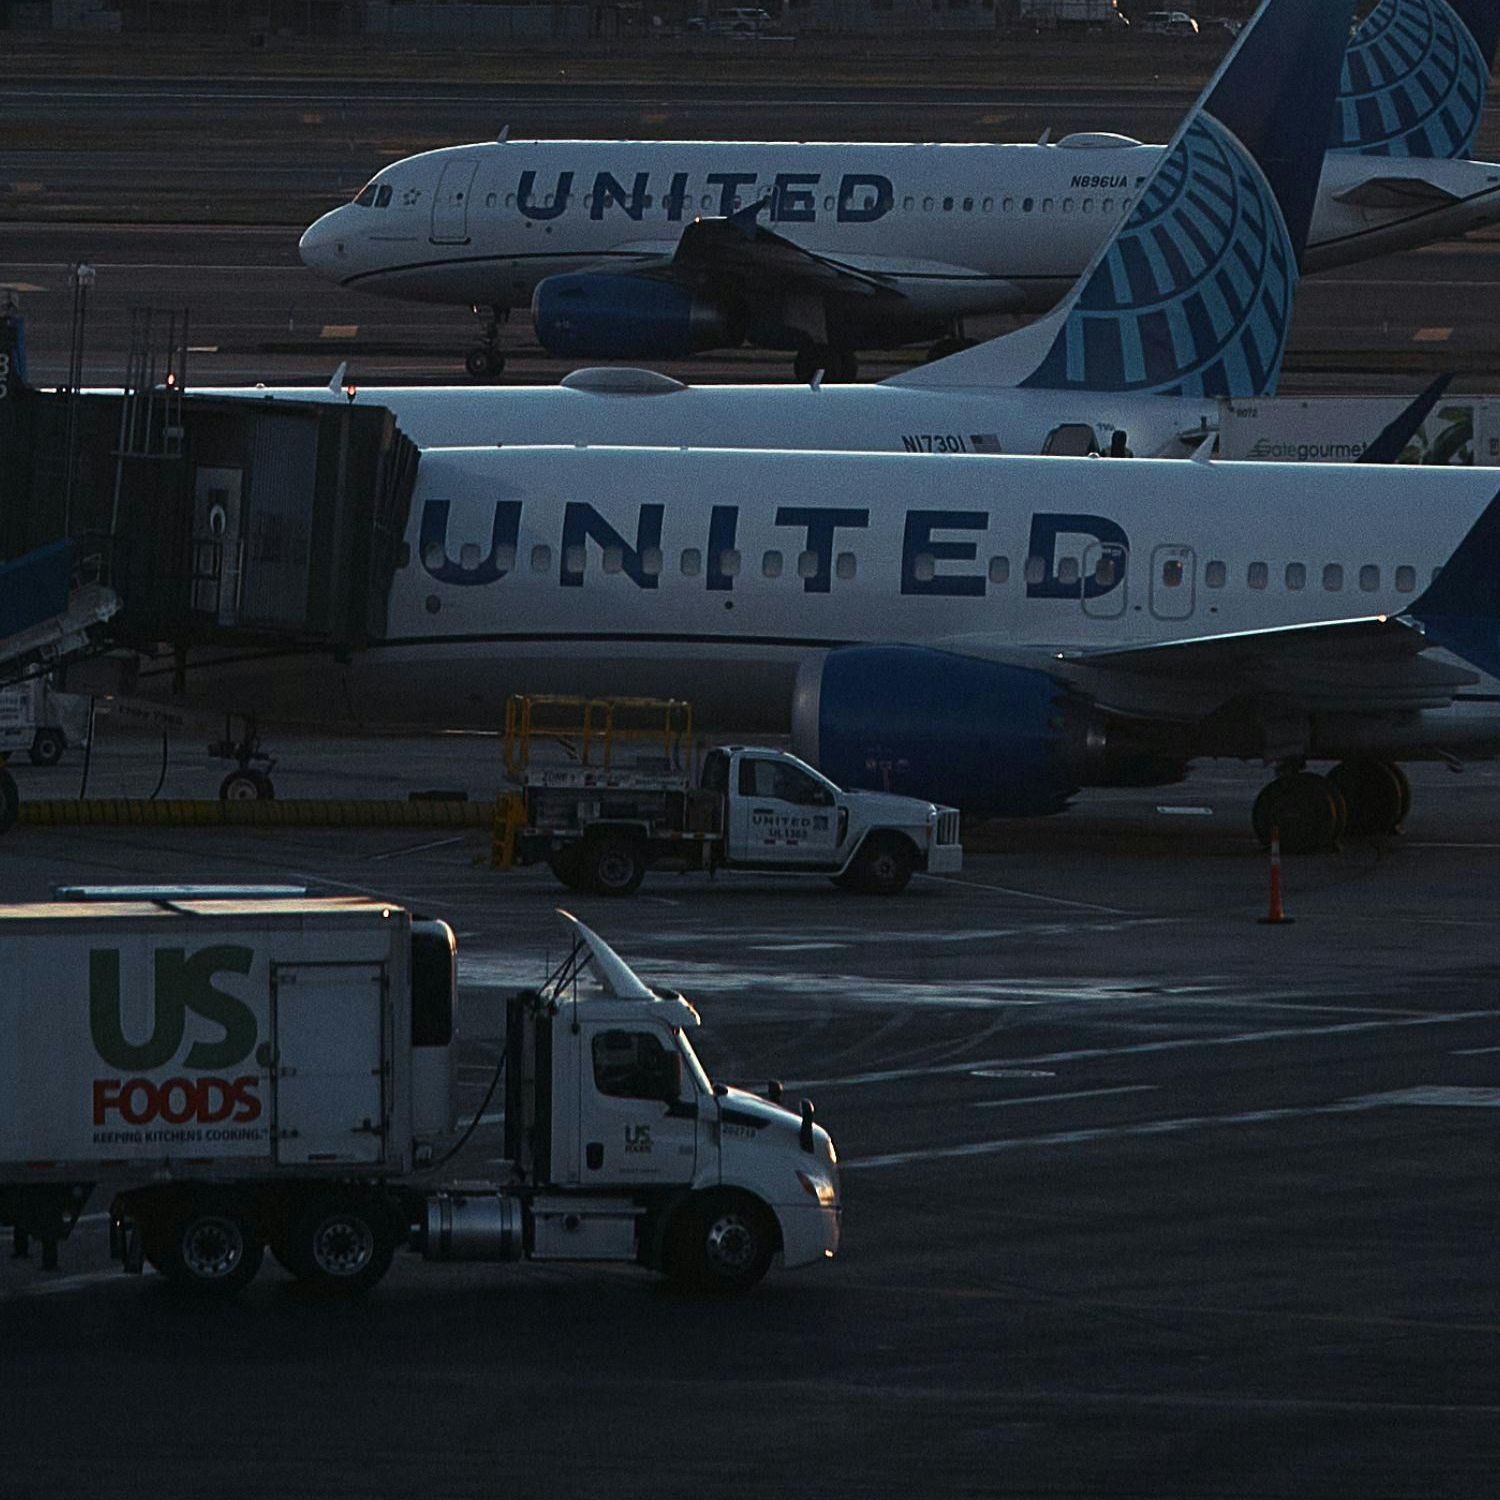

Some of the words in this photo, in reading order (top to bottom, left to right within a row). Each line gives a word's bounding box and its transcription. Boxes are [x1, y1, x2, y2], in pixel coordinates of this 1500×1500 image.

[1071, 175, 1127, 188] N896UA
[517, 170, 893, 223] UNITED
[901, 435, 966, 453] N17301
[419, 500, 1130, 600] UNITED
[752, 816, 811, 826] UNITED
[93, 1076, 262, 1125] FOODS
[93, 1131, 142, 1144] KEEPING
[145, 1129, 202, 1142] KITCHENS
